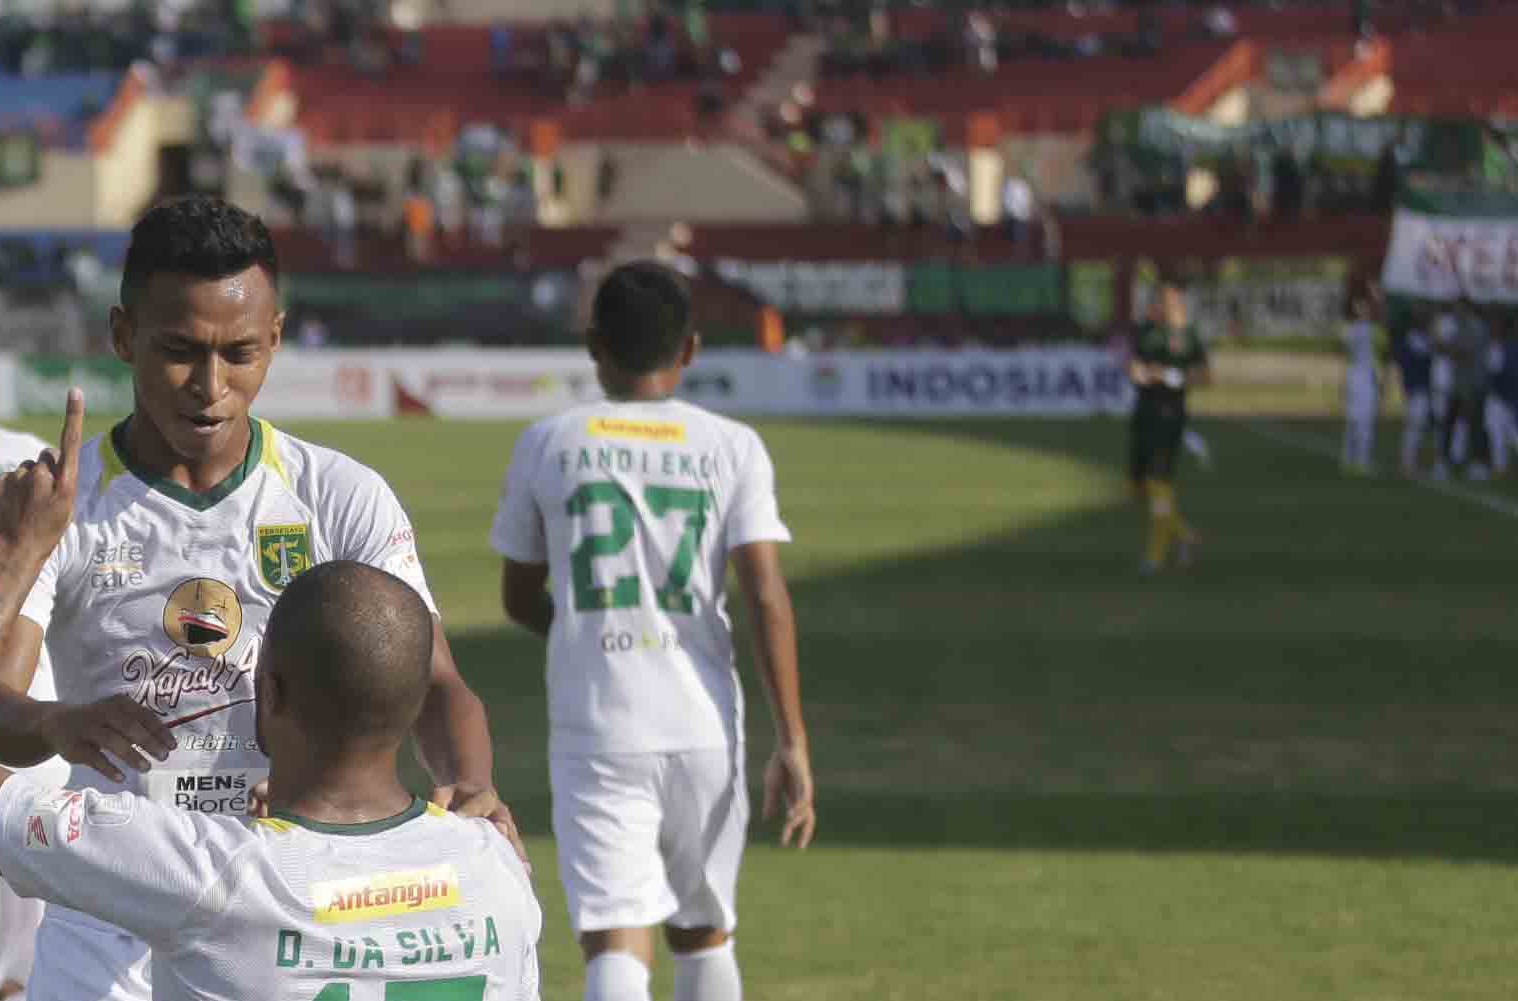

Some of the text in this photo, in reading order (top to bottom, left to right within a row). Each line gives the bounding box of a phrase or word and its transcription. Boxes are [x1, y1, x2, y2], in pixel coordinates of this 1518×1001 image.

[93, 541, 144, 564] safe
[565, 481, 710, 614] 27
[328, 876, 449, 913] Antangin
[333, 936, 386, 969] DA
[395, 915, 500, 965] SILVA
